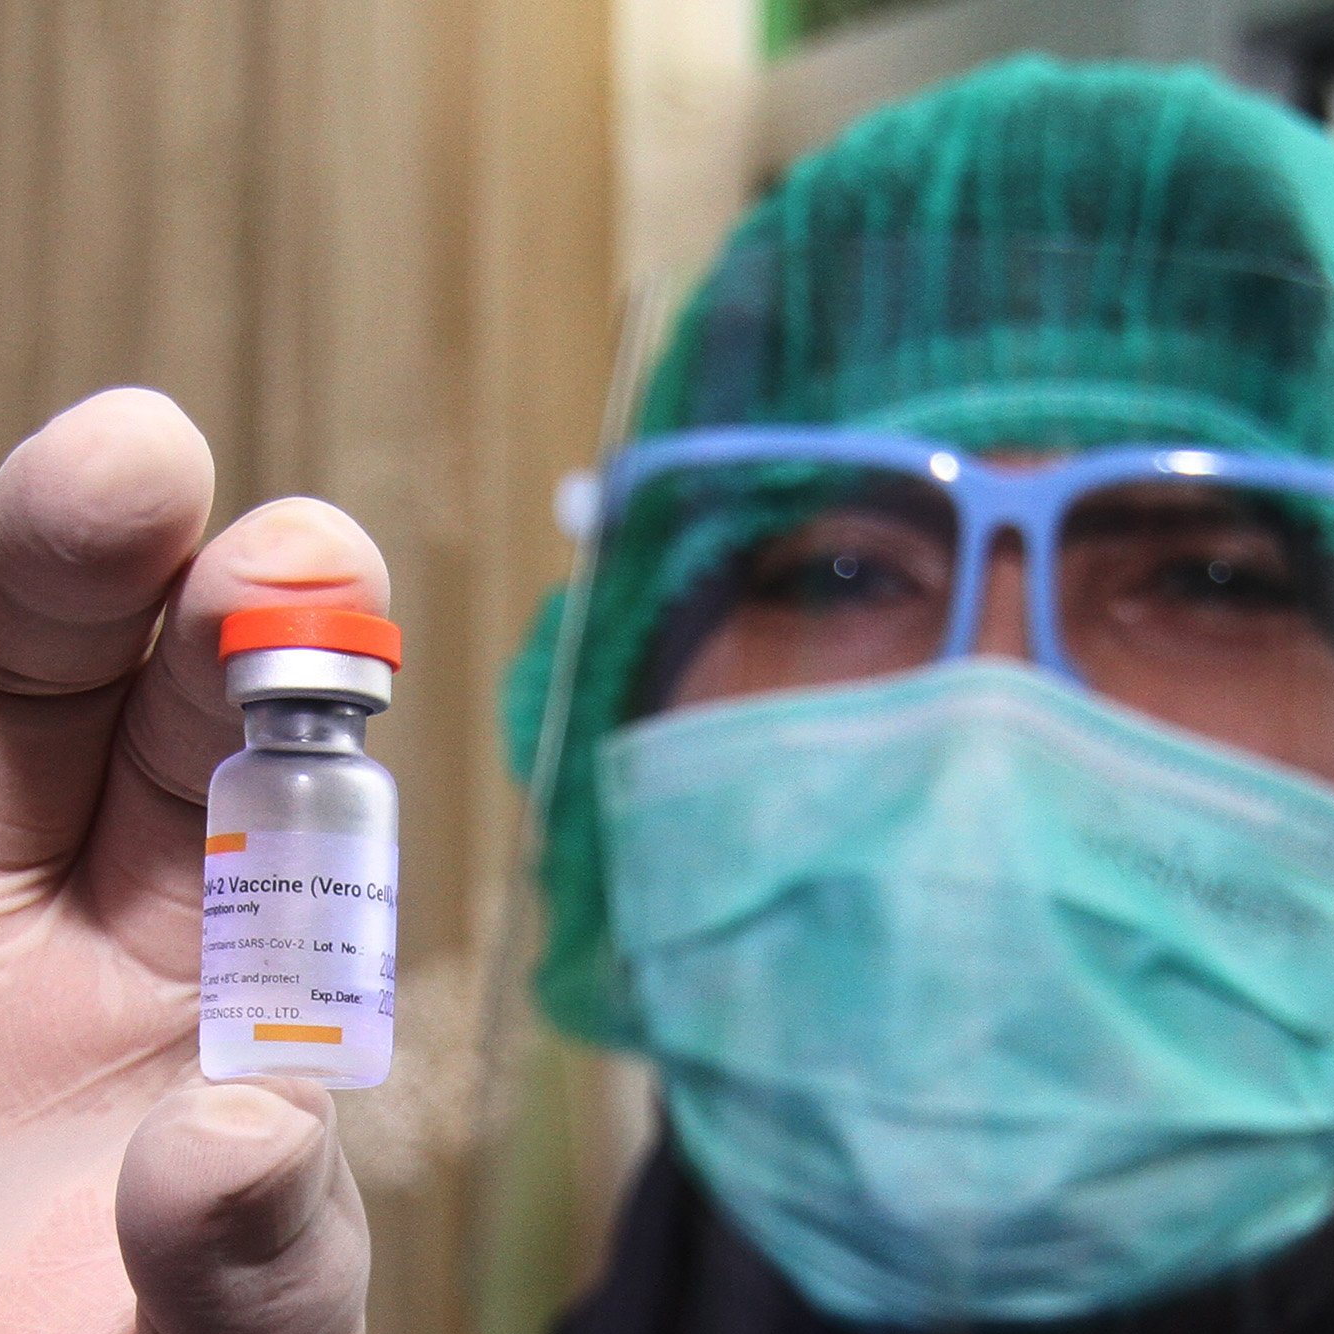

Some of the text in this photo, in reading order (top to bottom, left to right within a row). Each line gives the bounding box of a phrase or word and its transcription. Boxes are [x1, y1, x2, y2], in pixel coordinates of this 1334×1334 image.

[229, 874, 303, 894] Vaccine
[310, 875, 362, 898] (Vero
[237, 900, 260, 916] only
[238, 938, 305, 950] SARS-CoV-2
[313, 940, 334, 953] Lot
[241, 973, 259, 983] and
[261, 973, 300, 985] protect
